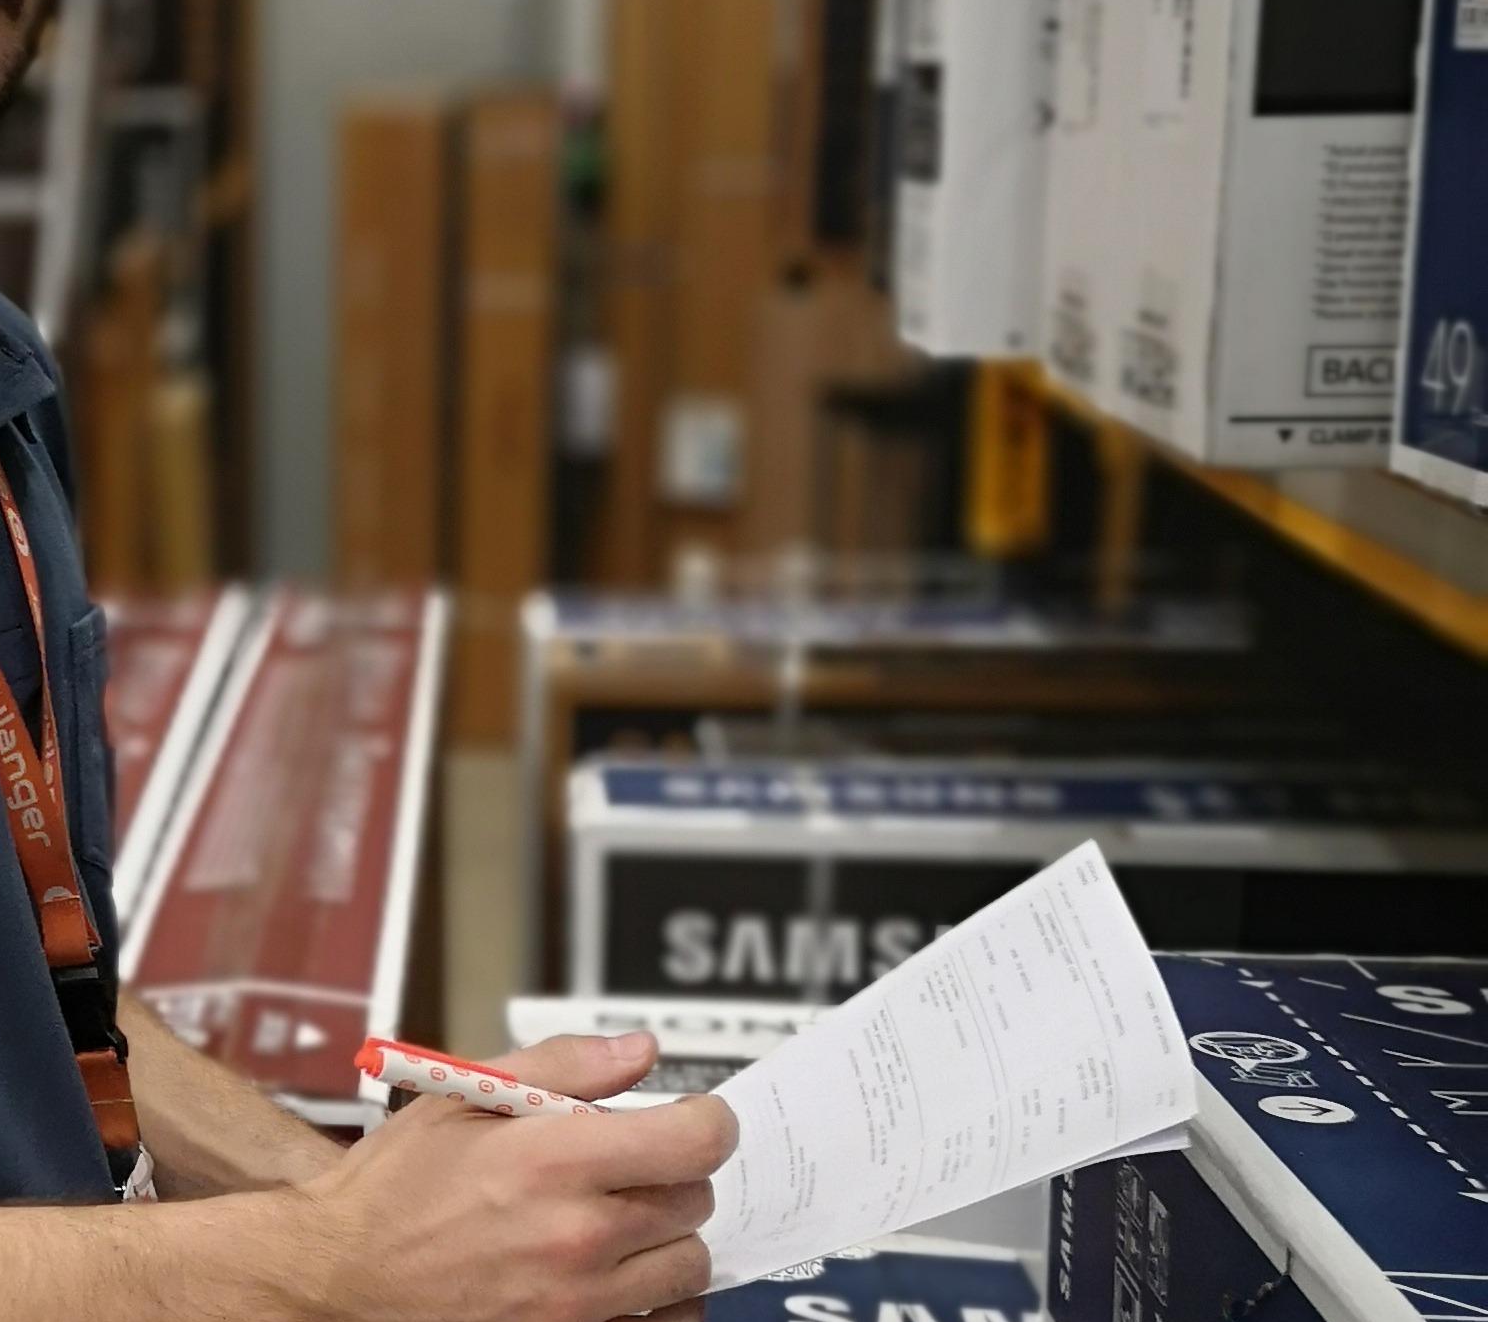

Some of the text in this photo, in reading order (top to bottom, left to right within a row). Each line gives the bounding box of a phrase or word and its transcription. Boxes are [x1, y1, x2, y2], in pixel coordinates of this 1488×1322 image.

[1322, 357, 1395, 386] BAC
[1420, 318, 1474, 415] 49
[661, 909, 955, 987] SAMS
